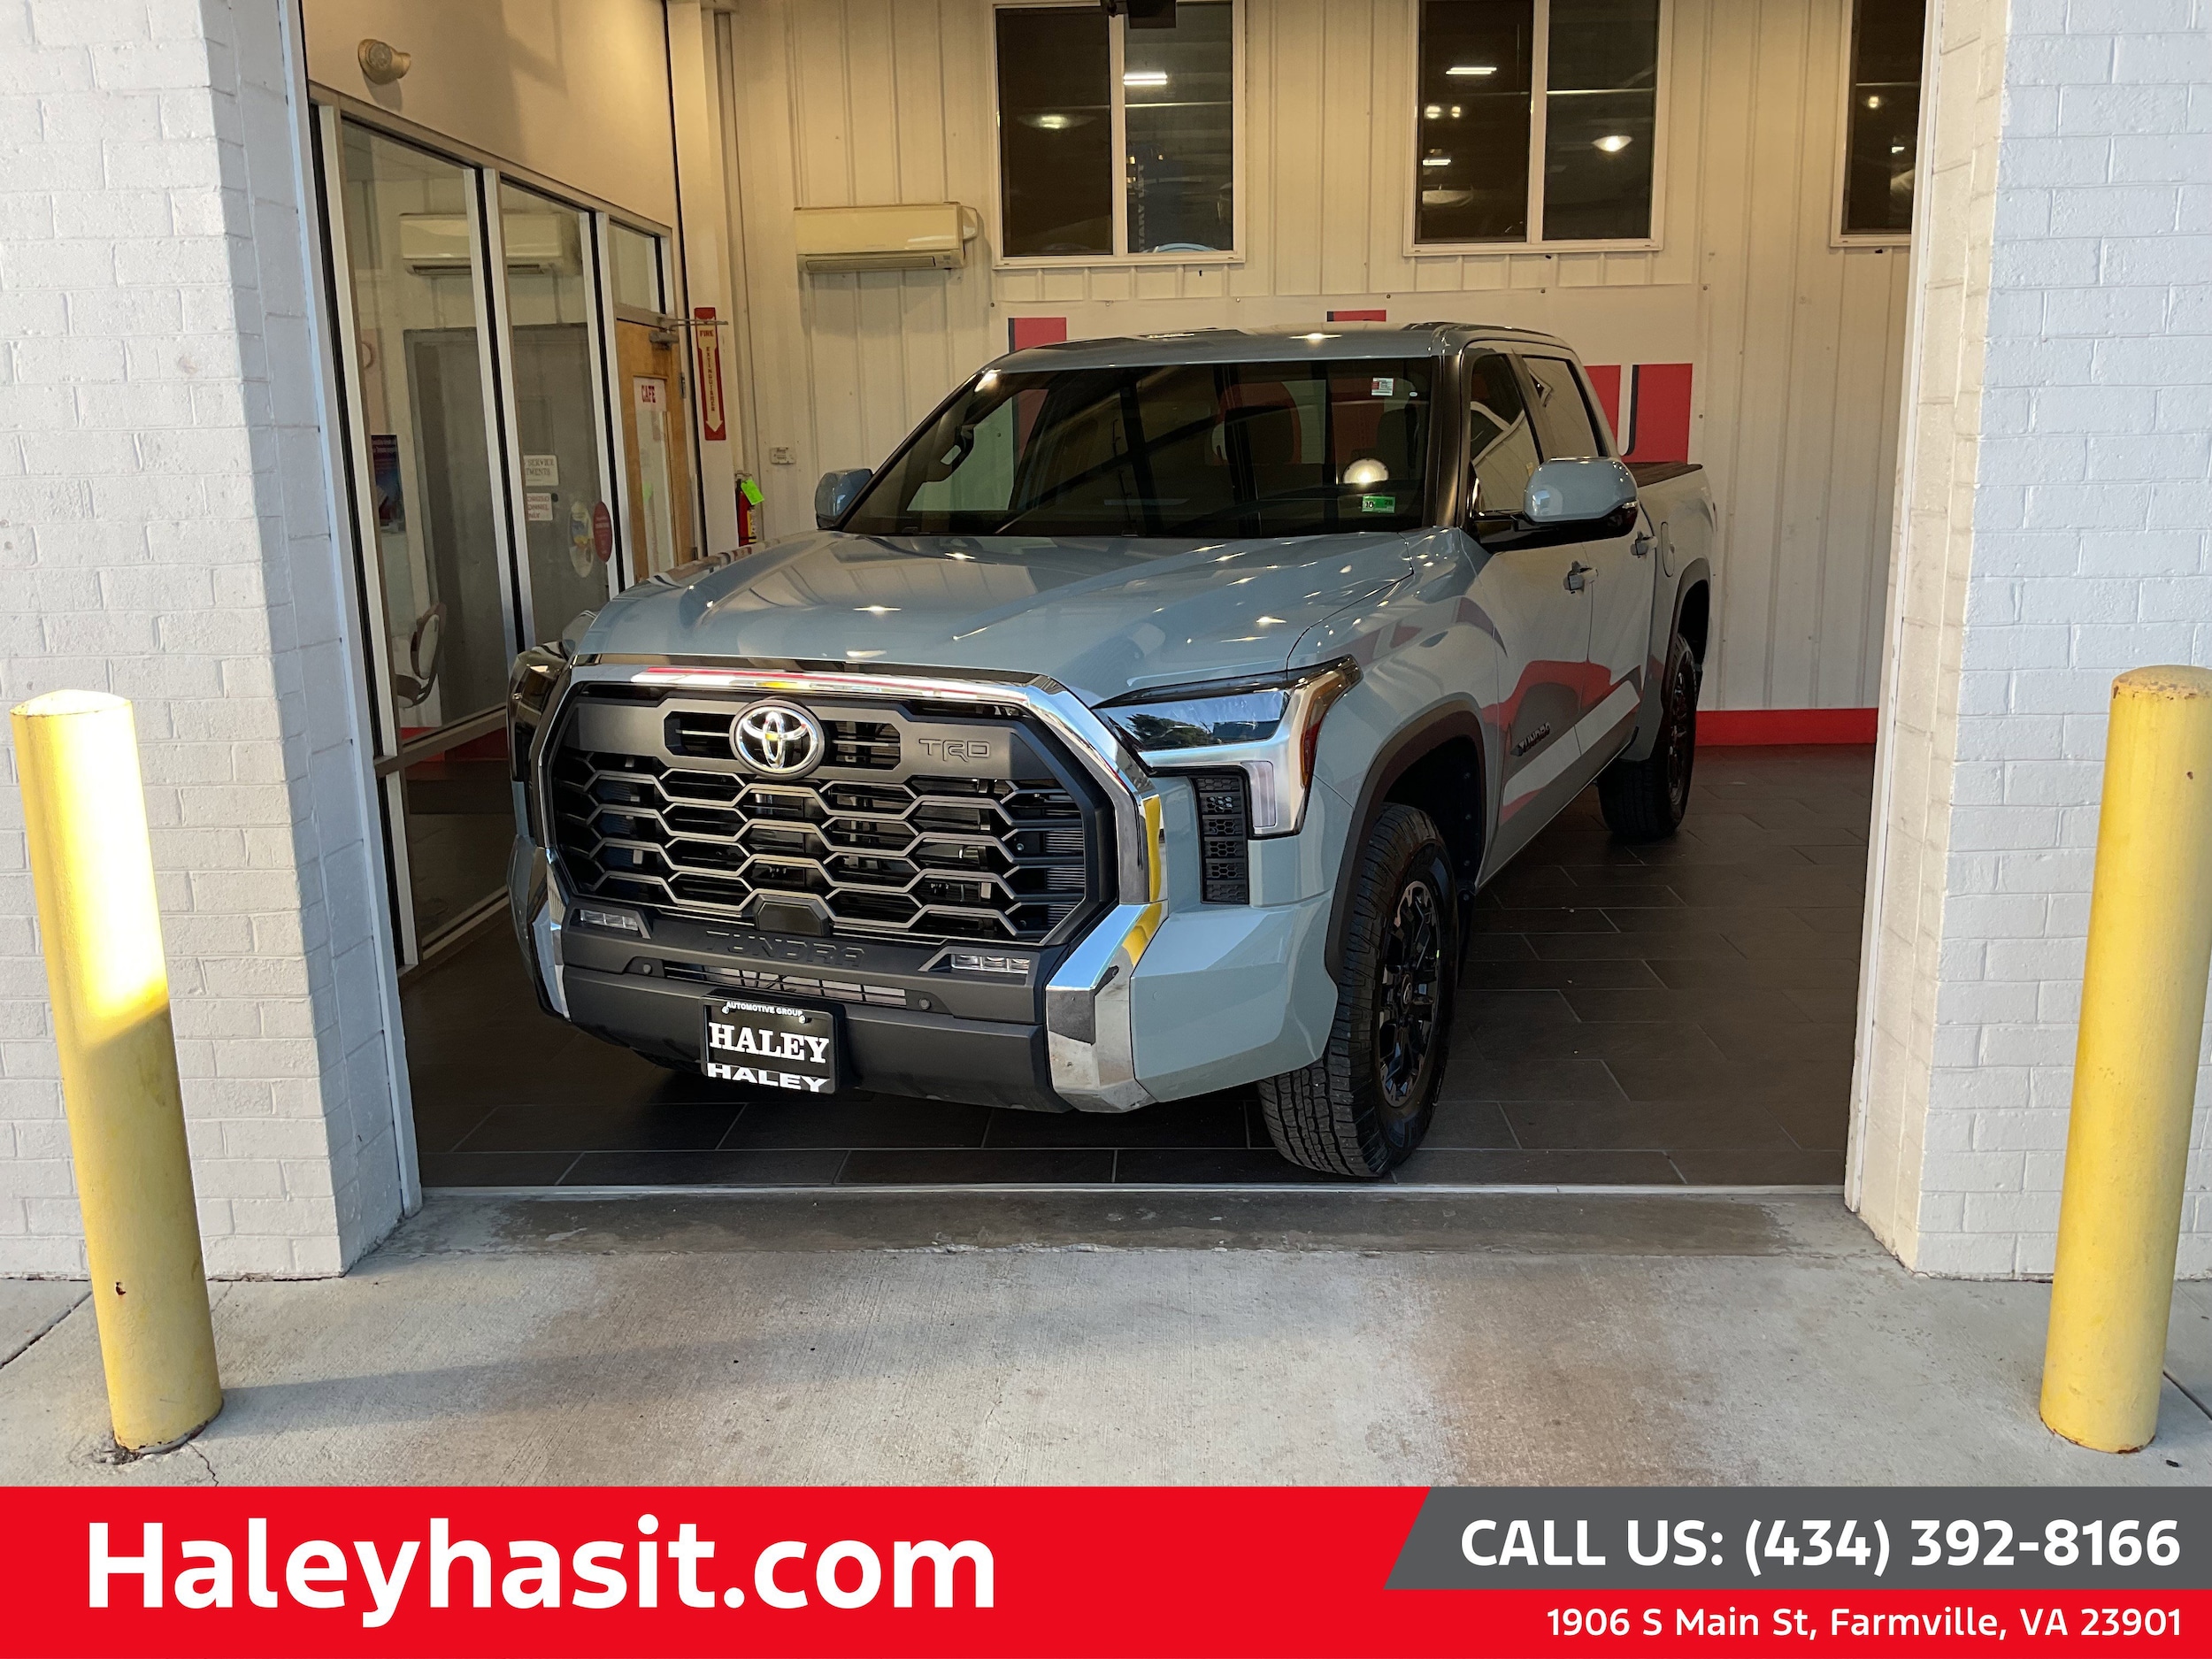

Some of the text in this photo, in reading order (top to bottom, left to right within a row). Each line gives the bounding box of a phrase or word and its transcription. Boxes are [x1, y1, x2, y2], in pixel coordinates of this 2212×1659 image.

[641, 385, 656, 403] CAFE
[706, 346, 715, 411] EXTINGUISHER
[918, 738, 990, 763] TRD
[706, 930, 865, 968] TUNDRA
[726, 1001, 804, 1018] AUTOMOTIVE GROUP
[708, 1022, 830, 1064] HALEY
[707, 1062, 831, 1093] HALEY
